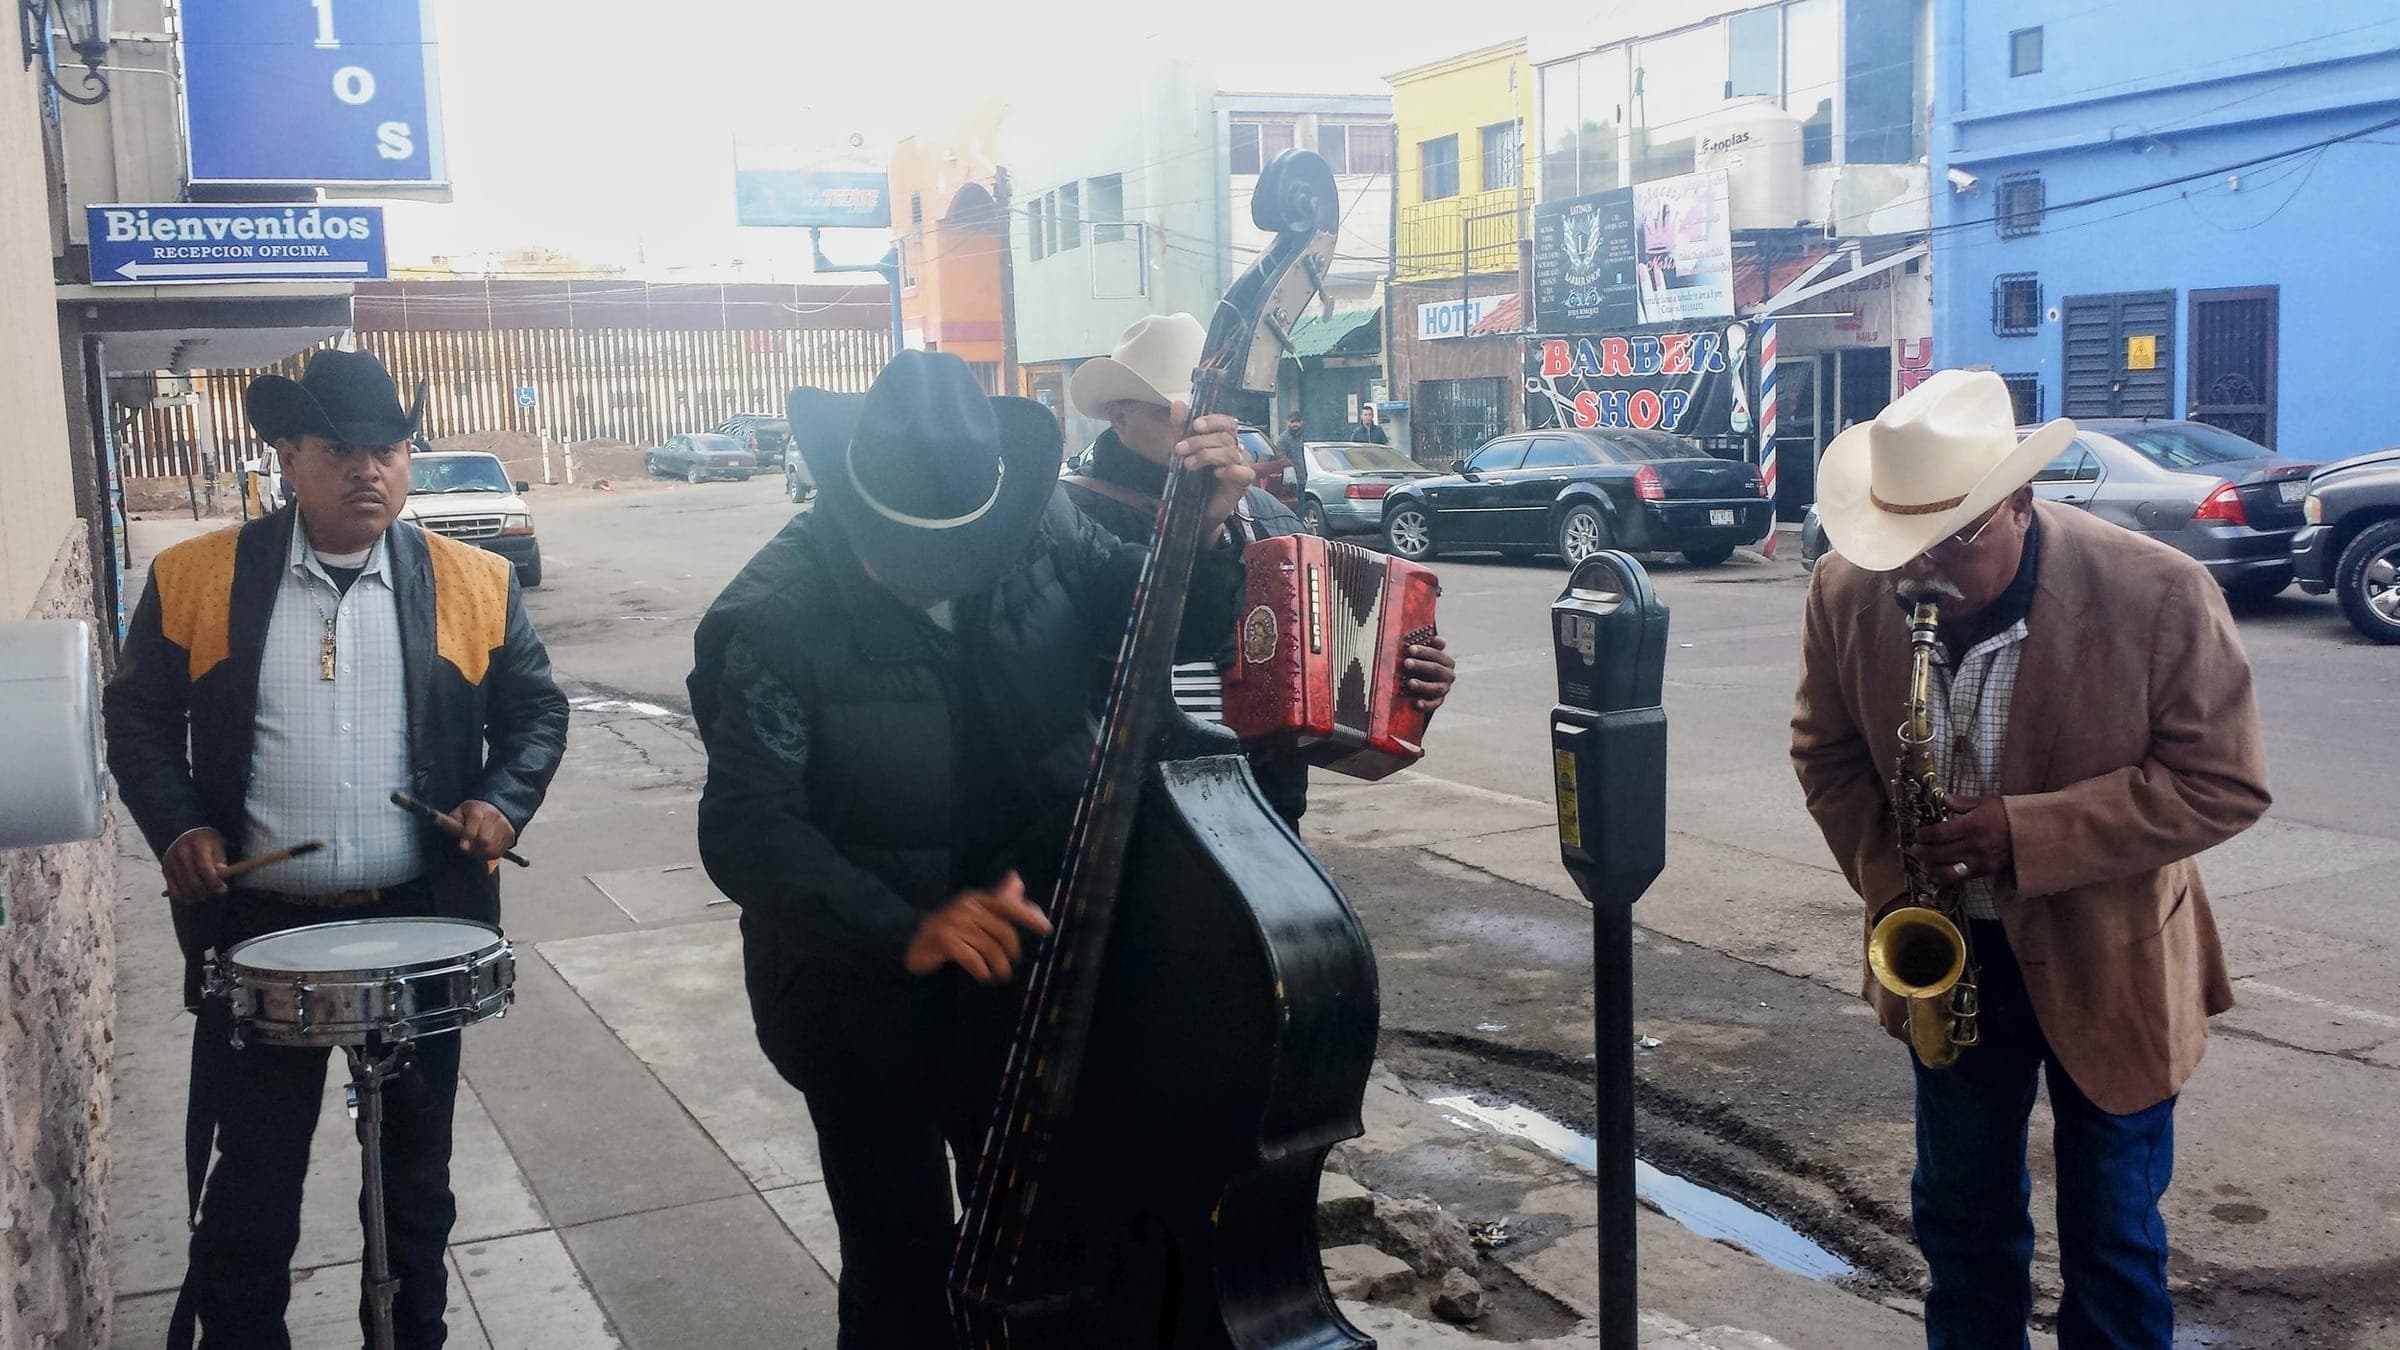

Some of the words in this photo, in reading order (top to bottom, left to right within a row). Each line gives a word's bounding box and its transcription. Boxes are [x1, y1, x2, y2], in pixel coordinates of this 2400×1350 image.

[104, 208, 370, 241] Bienvenidos
[153, 245, 253, 259] RECEPCION
[258, 245, 329, 257] OFICINA
[1542, 332, 1725, 376] BARBER
[1573, 389, 1690, 429] SHOP
